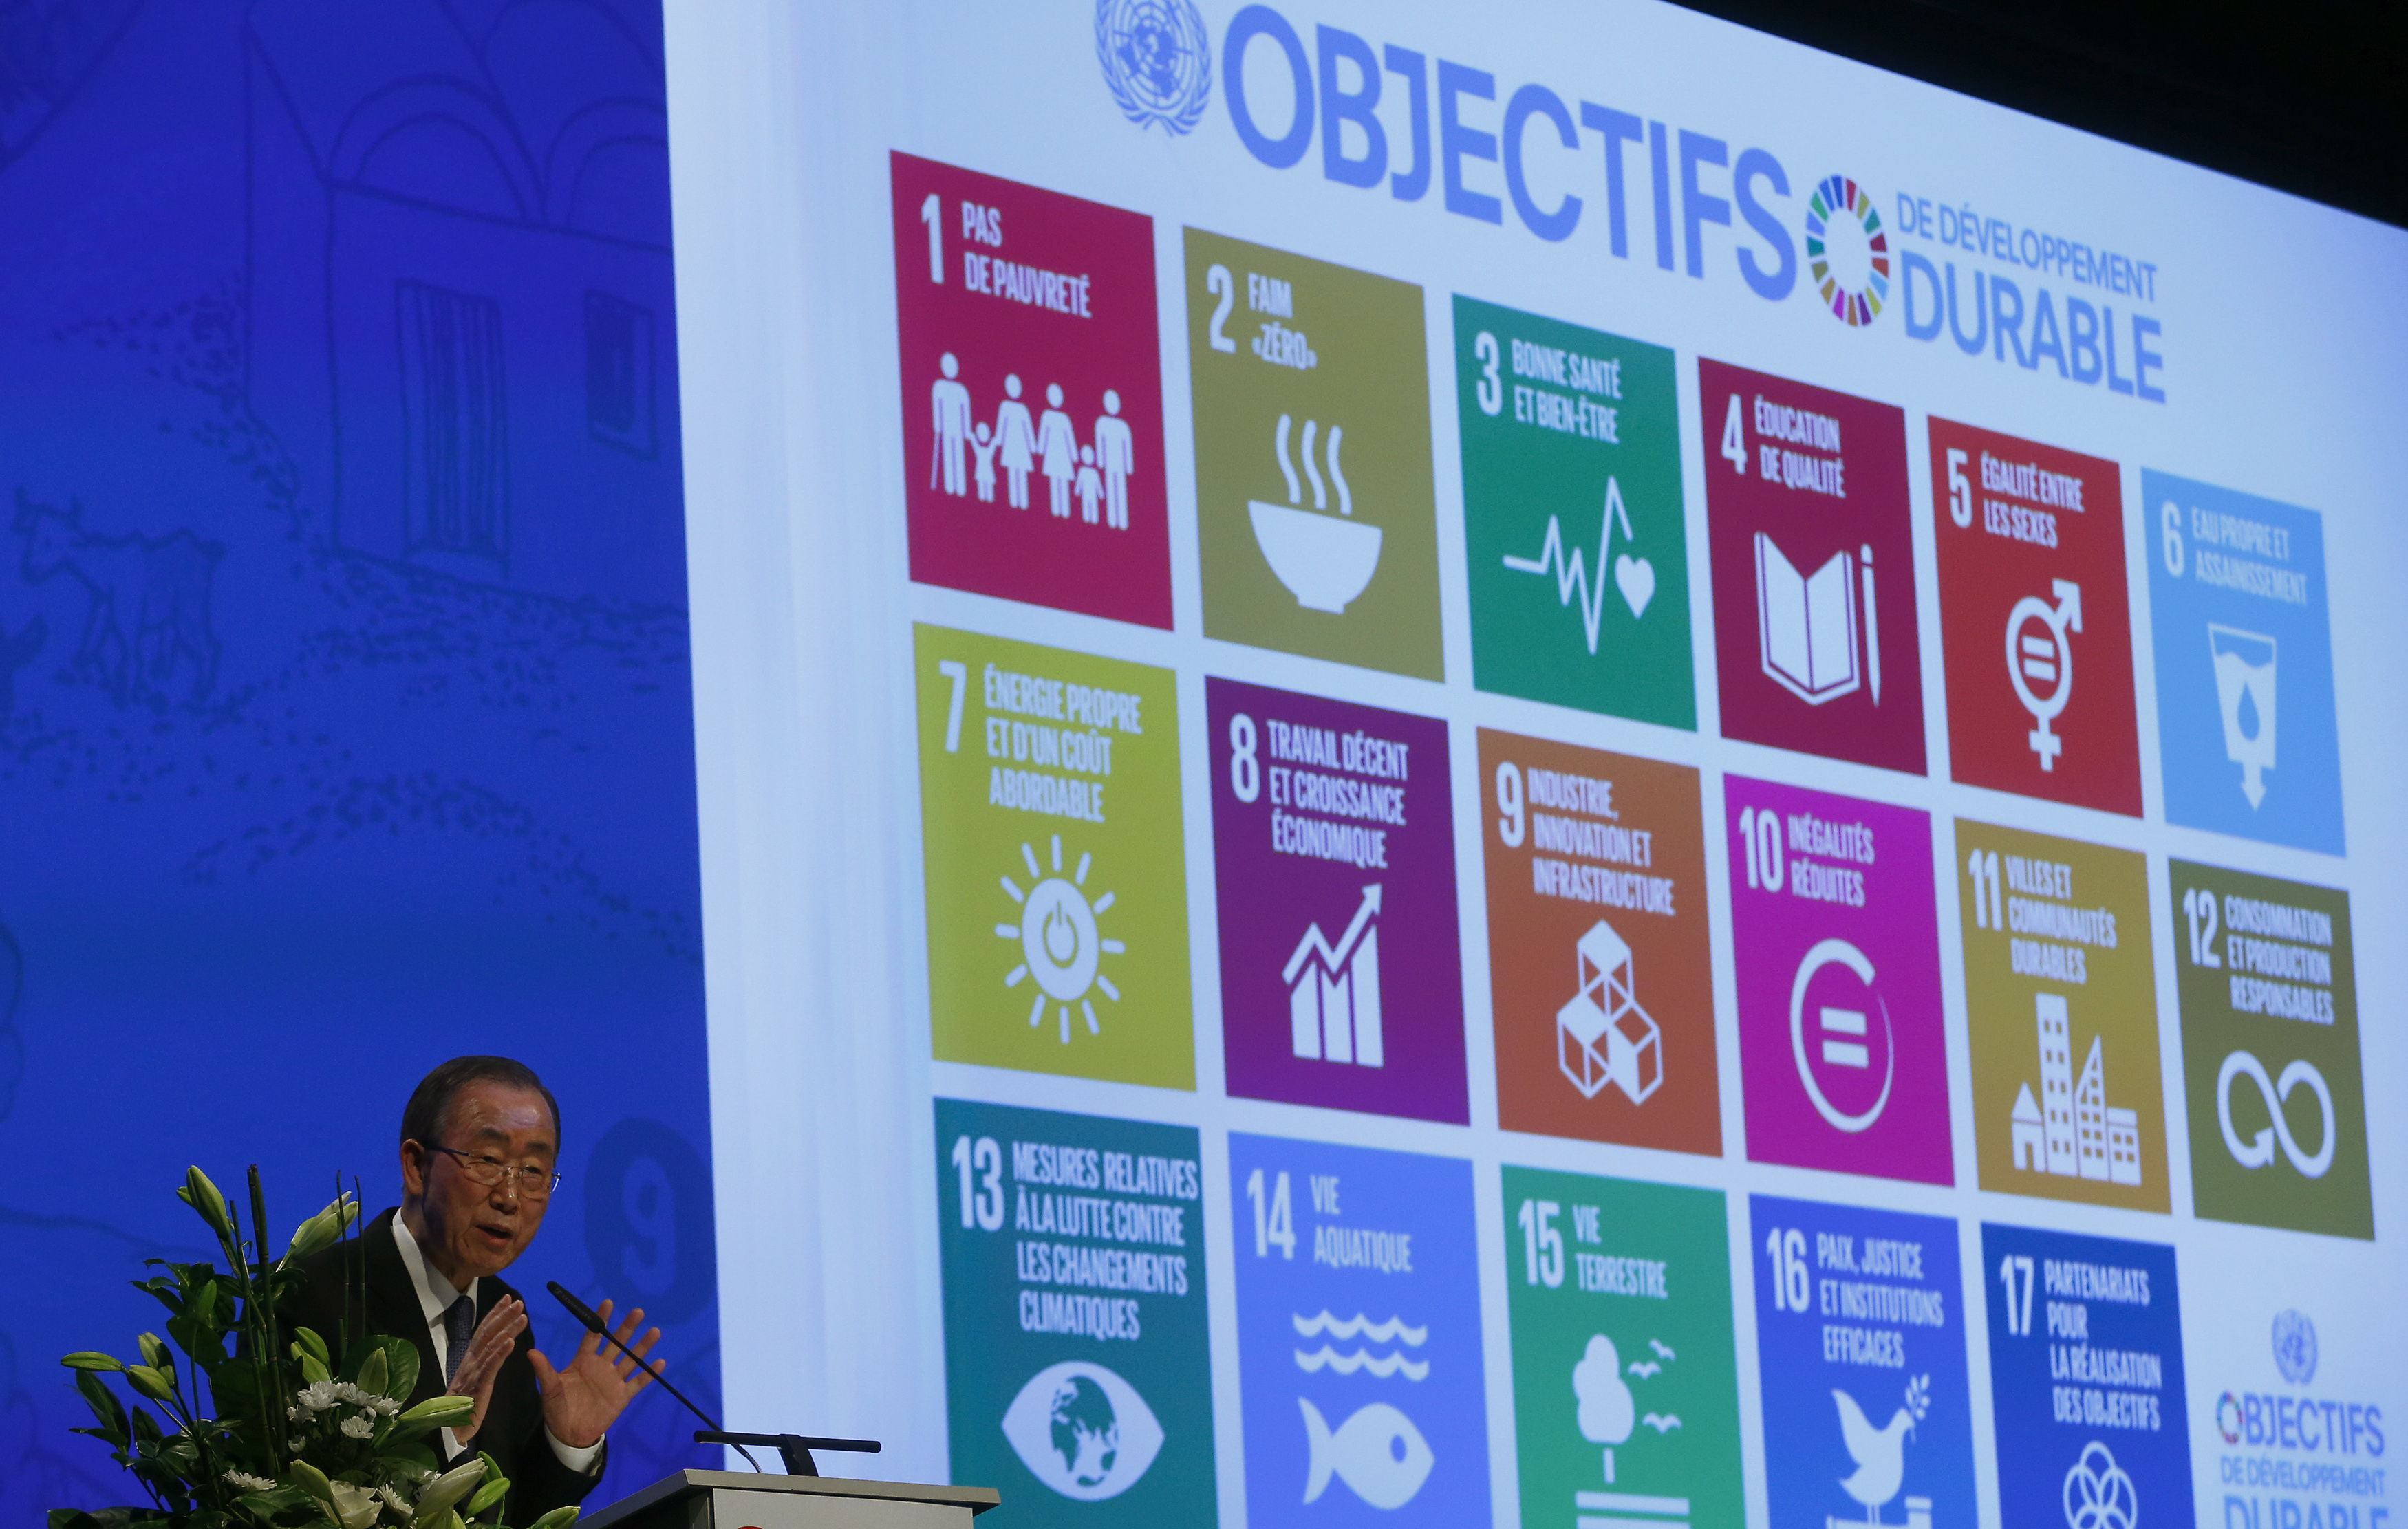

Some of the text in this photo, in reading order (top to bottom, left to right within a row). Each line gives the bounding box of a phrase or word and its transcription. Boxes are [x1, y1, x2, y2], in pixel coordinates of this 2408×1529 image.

[1222, 3, 1798, 302] OBJECTIFS
[921, 193, 944, 285] 1
[962, 200, 1003, 248] PAS
[1897, 191, 2158, 303] DE DÉVELOPPEMENT
[964, 251, 1093, 319] DE PAUVRETÉ
[1207, 263, 1236, 354] 2
[1247, 272, 1293, 319] FAIM
[1900, 248, 2166, 404] DURABLE
[1474, 331, 1503, 417] 3
[1512, 338, 1623, 400] BONNE SANTÉ
[1514, 384, 1620, 445] ET BIEN-ÊTRE
[1721, 393, 1748, 475] 4
[1754, 393, 1841, 454] ÉDUCATION
[1759, 444, 1847, 499] DE QUALITÉ
[1946, 446, 1973, 529] 5
[1980, 450, 2085, 514] ÉGALITÉ ENTRE
[1983, 498, 2058, 549] LES SEXES
[2161, 500, 2185, 578] 6
[2192, 506, 2219, 545] EAU
[2272, 526, 2290, 562] ET
[939, 659, 967, 753] 7
[984, 662, 1143, 735] ÉNERGIE PROPRE
[985, 716, 1010, 759] ET
[1060, 728, 1113, 777] COÛT
[1229, 712, 1260, 804] 8
[1266, 718, 1409, 782] TRAVAIL DÉCENT
[989, 766, 1106, 824] ABORDABLE
[1269, 765, 1406, 827] ET CROISSANCE
[1496, 760, 1525, 849] 9
[1271, 807, 1389, 870] ÉCONOMIQUE
[1532, 812, 1651, 868] INNOVATION ET
[1739, 805, 1785, 893] 10
[1787, 812, 1875, 865] INÉGALITÉS
[1532, 856, 1676, 917] INFRASTRUCTURE
[1790, 856, 1866, 908] RÉDUITES
[1968, 848, 2003, 932] 11
[2004, 854, 2072, 900] VILLES ET
[2008, 896, 2118, 950] COMMUNAUTÉS
[2183, 887, 2222, 970] 12
[2224, 894, 2333, 948] CONSOMMATION
[2010, 937, 2087, 985] DURABLES
[2226, 934, 2332, 986] ET PRODUCTION
[2229, 974, 2336, 1026] RESPONSABLES
[952, 1134, 1005, 1233] 13
[1011, 1140, 1199, 1202] MESURES RELATIVES
[1309, 1173, 1341, 1215] VIE
[622, 1156, 676, 1297] 9
[1015, 1184, 1185, 1248] À LA LUTTE CONTRE
[1247, 1168, 1297, 1261] 14
[1518, 1198, 1565, 1290] 15
[1571, 1204, 1602, 1246] VIE
[1016, 1239, 1189, 1297] LES CHANGEMENTS
[1313, 1224, 1413, 1275] AQUATIQUE
[1574, 1251, 1669, 1300] TERRESTRE
[1766, 1226, 1811, 1314] 16
[1860, 1237, 1924, 1281] JUSTICE
[1819, 1278, 1945, 1329] ET INSTITUTIONS
[1999, 1254, 2034, 1337] 17
[2043, 1257, 2151, 1307] PARTENARIATS
[1018, 1289, 1141, 1342] CLIMATIQUES
[1823, 1323, 1906, 1369] EFFICACES
[2045, 1299, 2089, 1341] POUR
[2050, 1342, 2162, 1391] LA RÉALISATION
[2052, 1384, 2162, 1433] DES OBJECTIFS
[2220, 1455, 2244, 1486] DE
